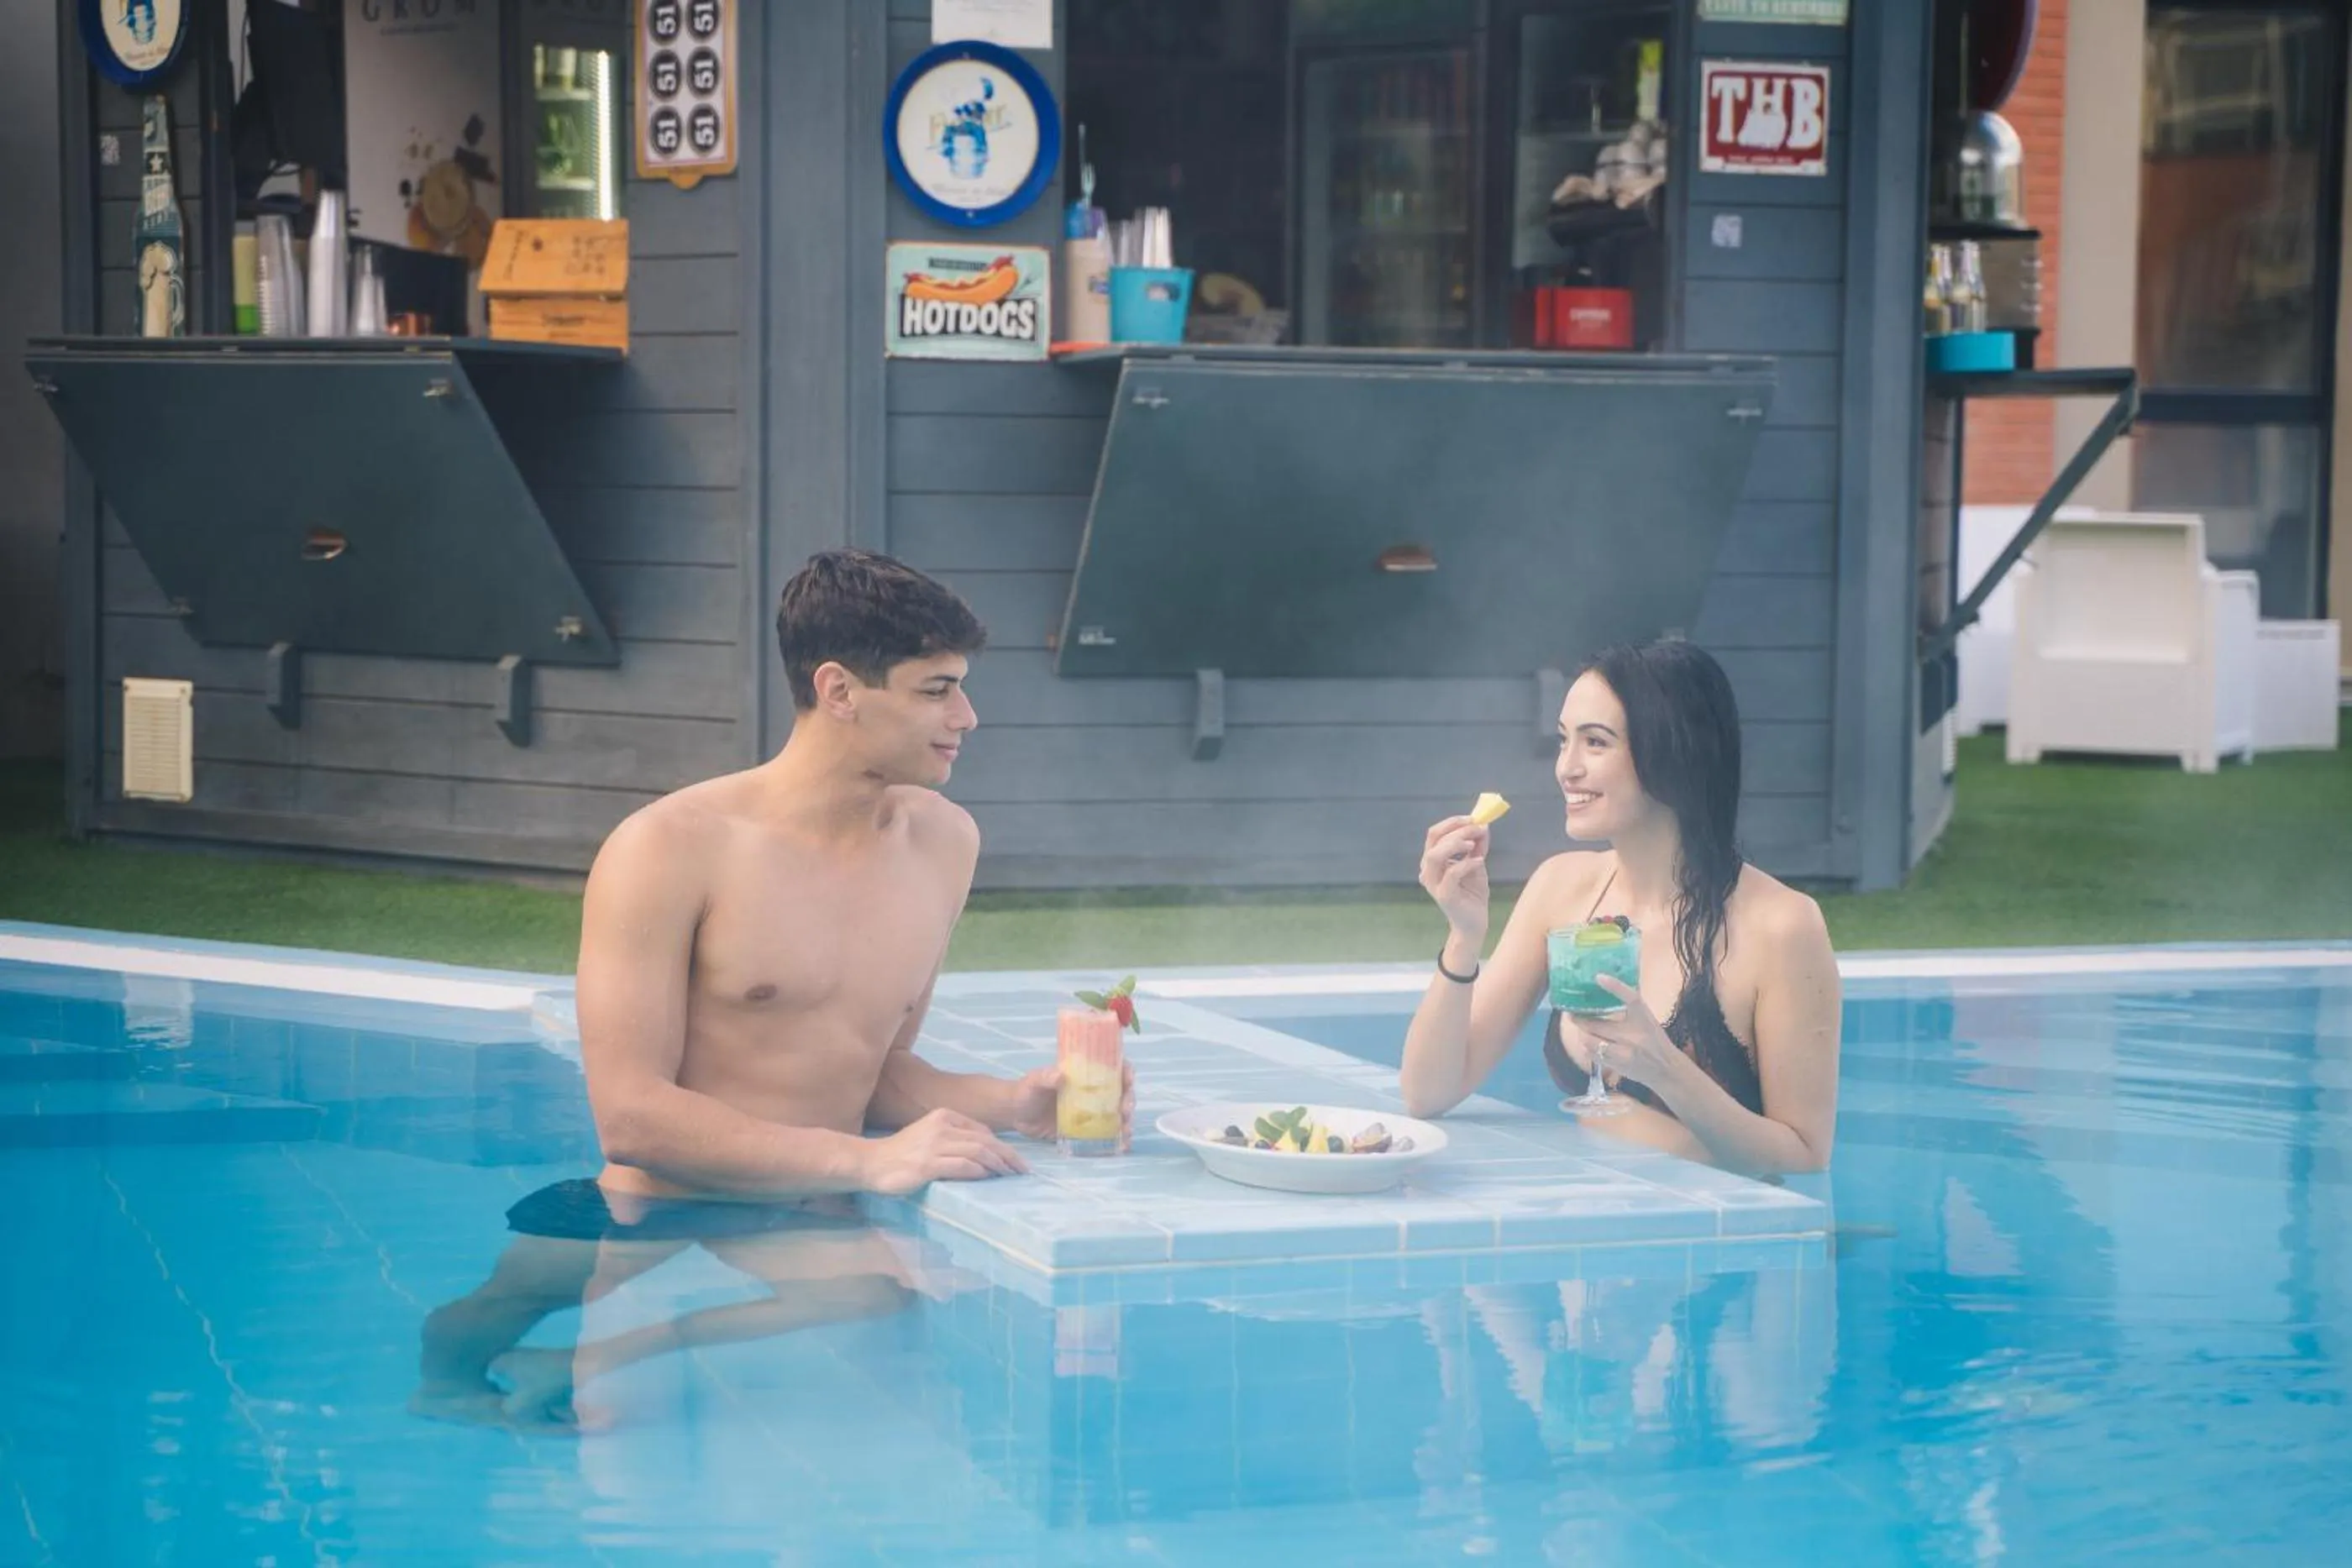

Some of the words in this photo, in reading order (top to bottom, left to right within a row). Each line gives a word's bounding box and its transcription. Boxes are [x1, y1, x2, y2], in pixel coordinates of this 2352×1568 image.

[656, 7, 675, 34] 51
[694, 3, 713, 32] 51
[657, 62, 675, 92] 51
[695, 59, 713, 88] 51
[1711, 75, 1822, 150] THB
[658, 118, 677, 148] 51
[696, 115, 714, 145] 51
[903, 296, 1035, 339] HOTDOGS
